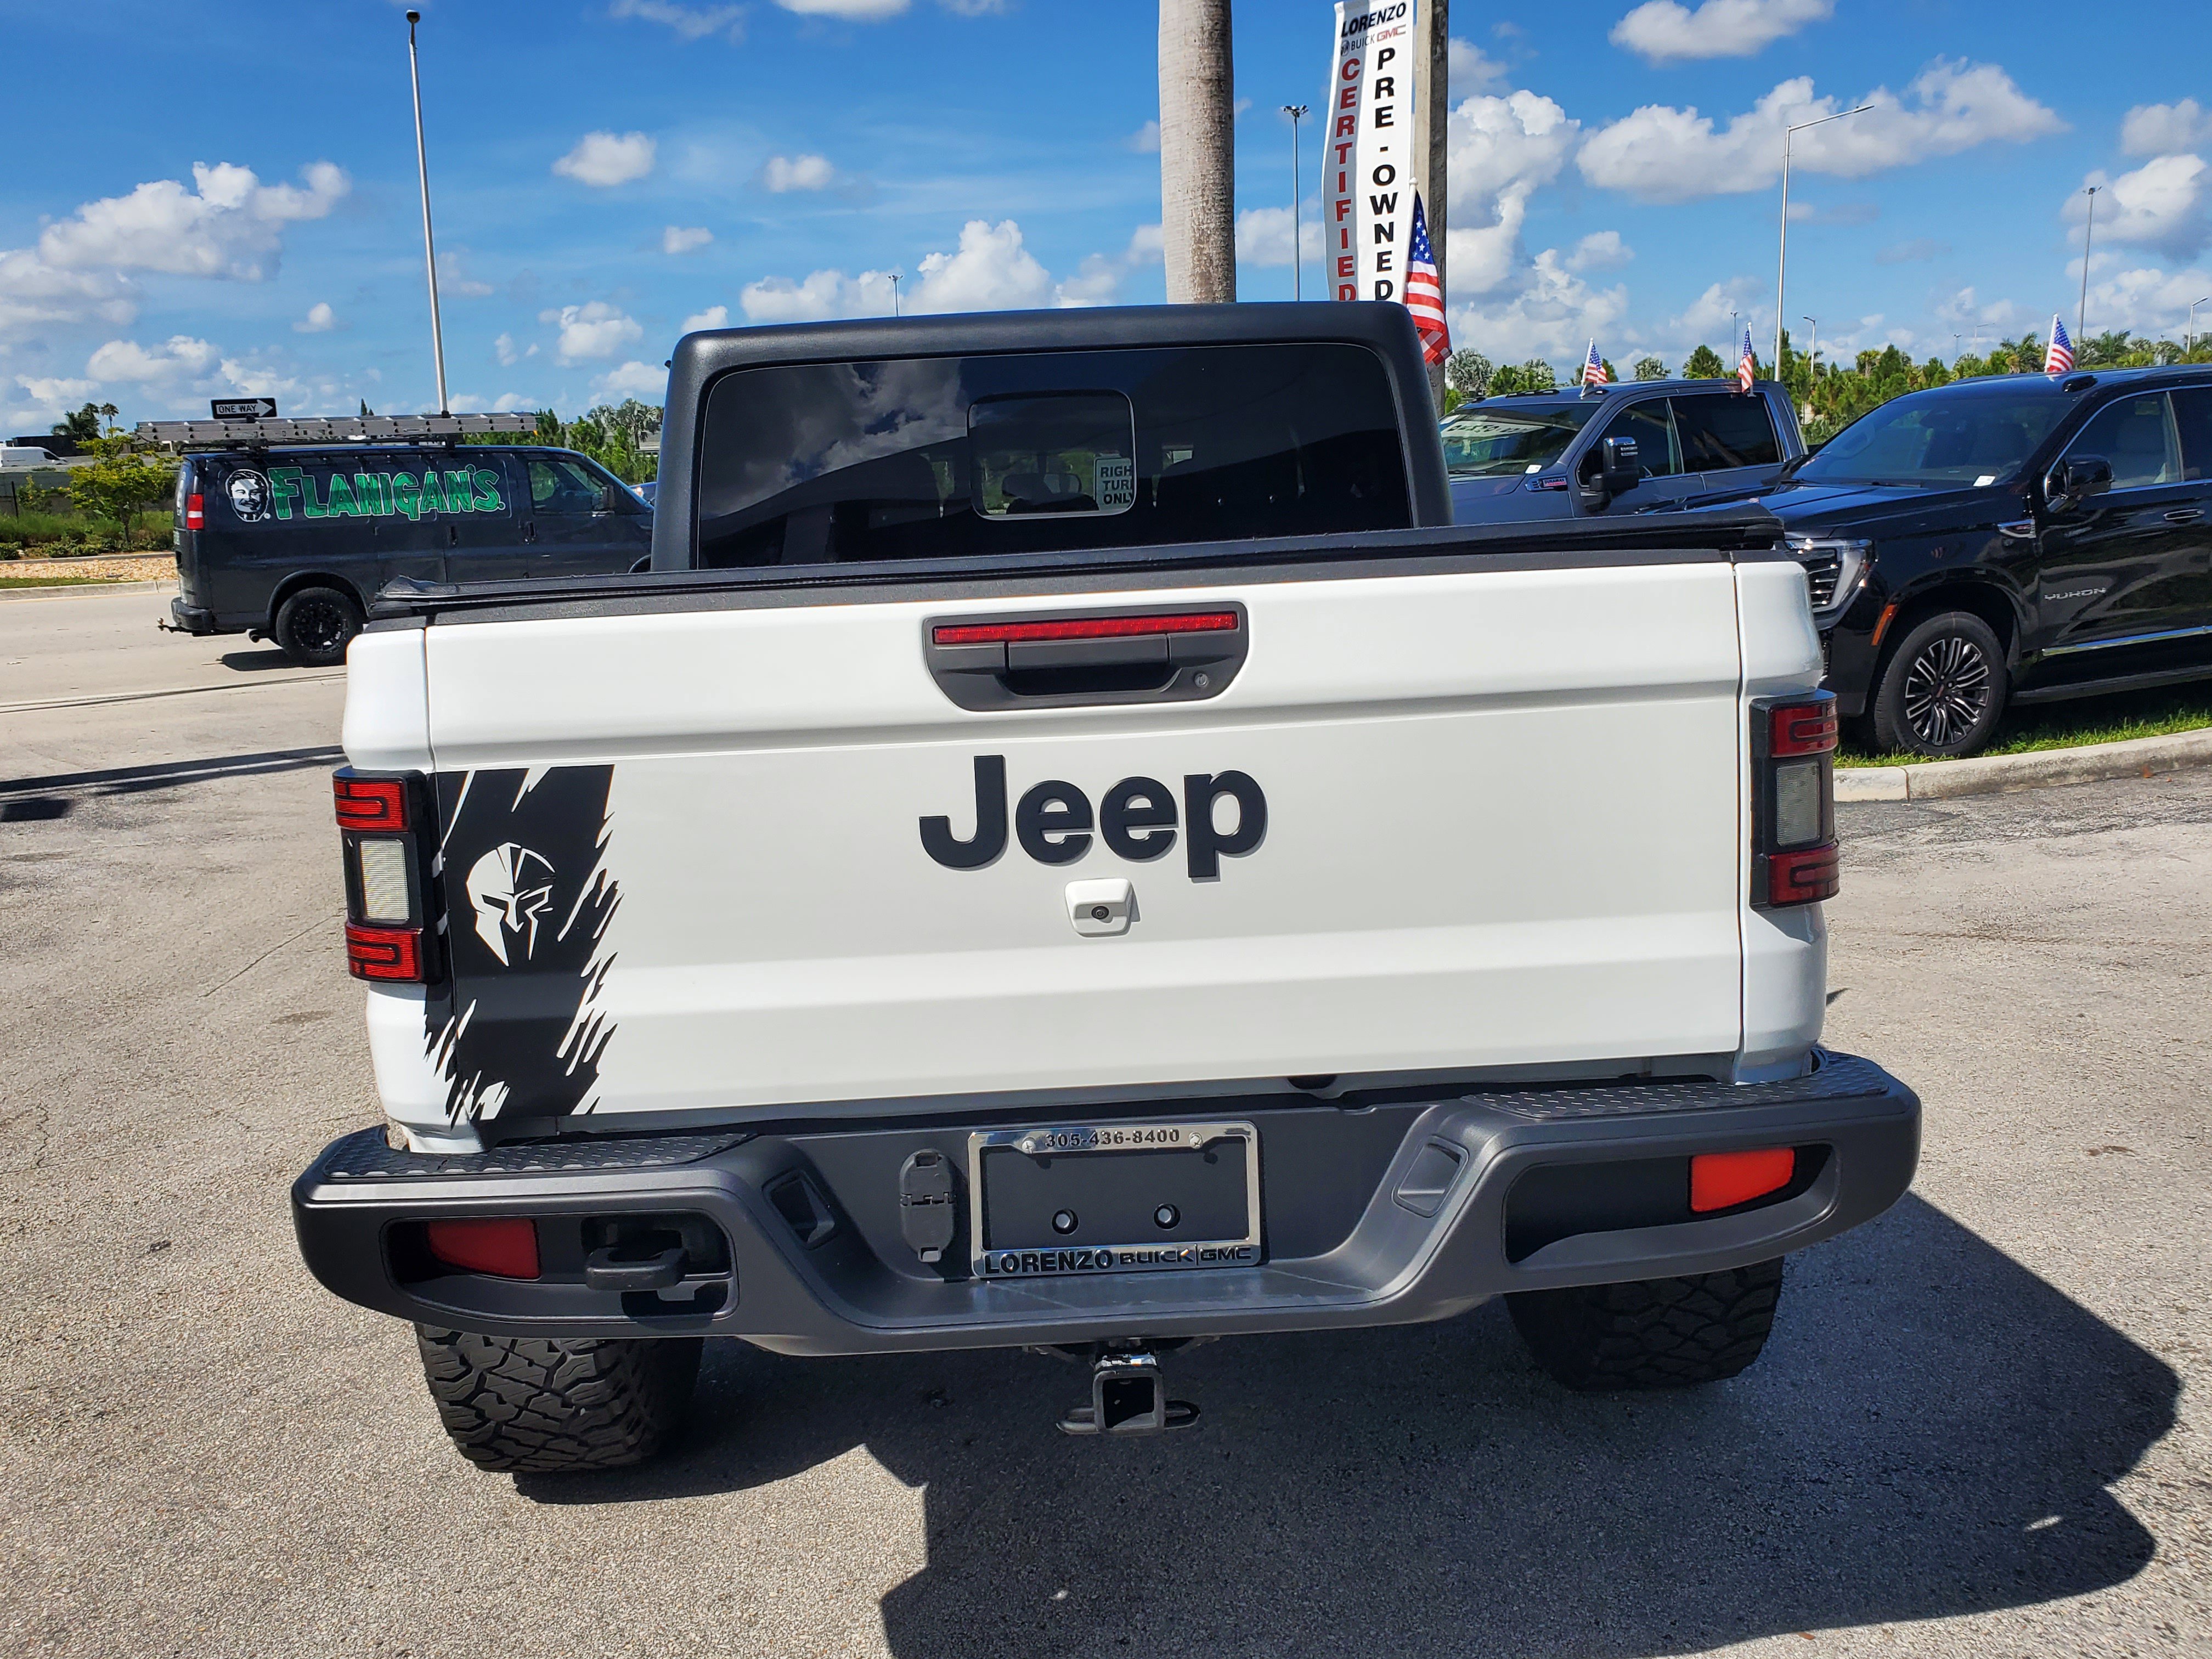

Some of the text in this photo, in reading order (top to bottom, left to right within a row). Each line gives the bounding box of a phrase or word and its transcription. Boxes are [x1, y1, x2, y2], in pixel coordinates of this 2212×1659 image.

[1341, 2, 1406, 37] LORENZO
[1351, 24, 1406, 50] BUICK GMC
[1335, 58, 1360, 301] CERTIFIED
[219, 404, 257, 413] ONE WAY
[1101, 466, 1132, 477] RIGH
[267, 465, 499, 521] FLANIGAN'S
[2044, 588, 2107, 600] YUKON
[919, 755, 1267, 879] Jeep
[1045, 1128, 1180, 1147] 305-436-8400
[984, 1246, 1251, 1274] LORENZO BUICK GMC
